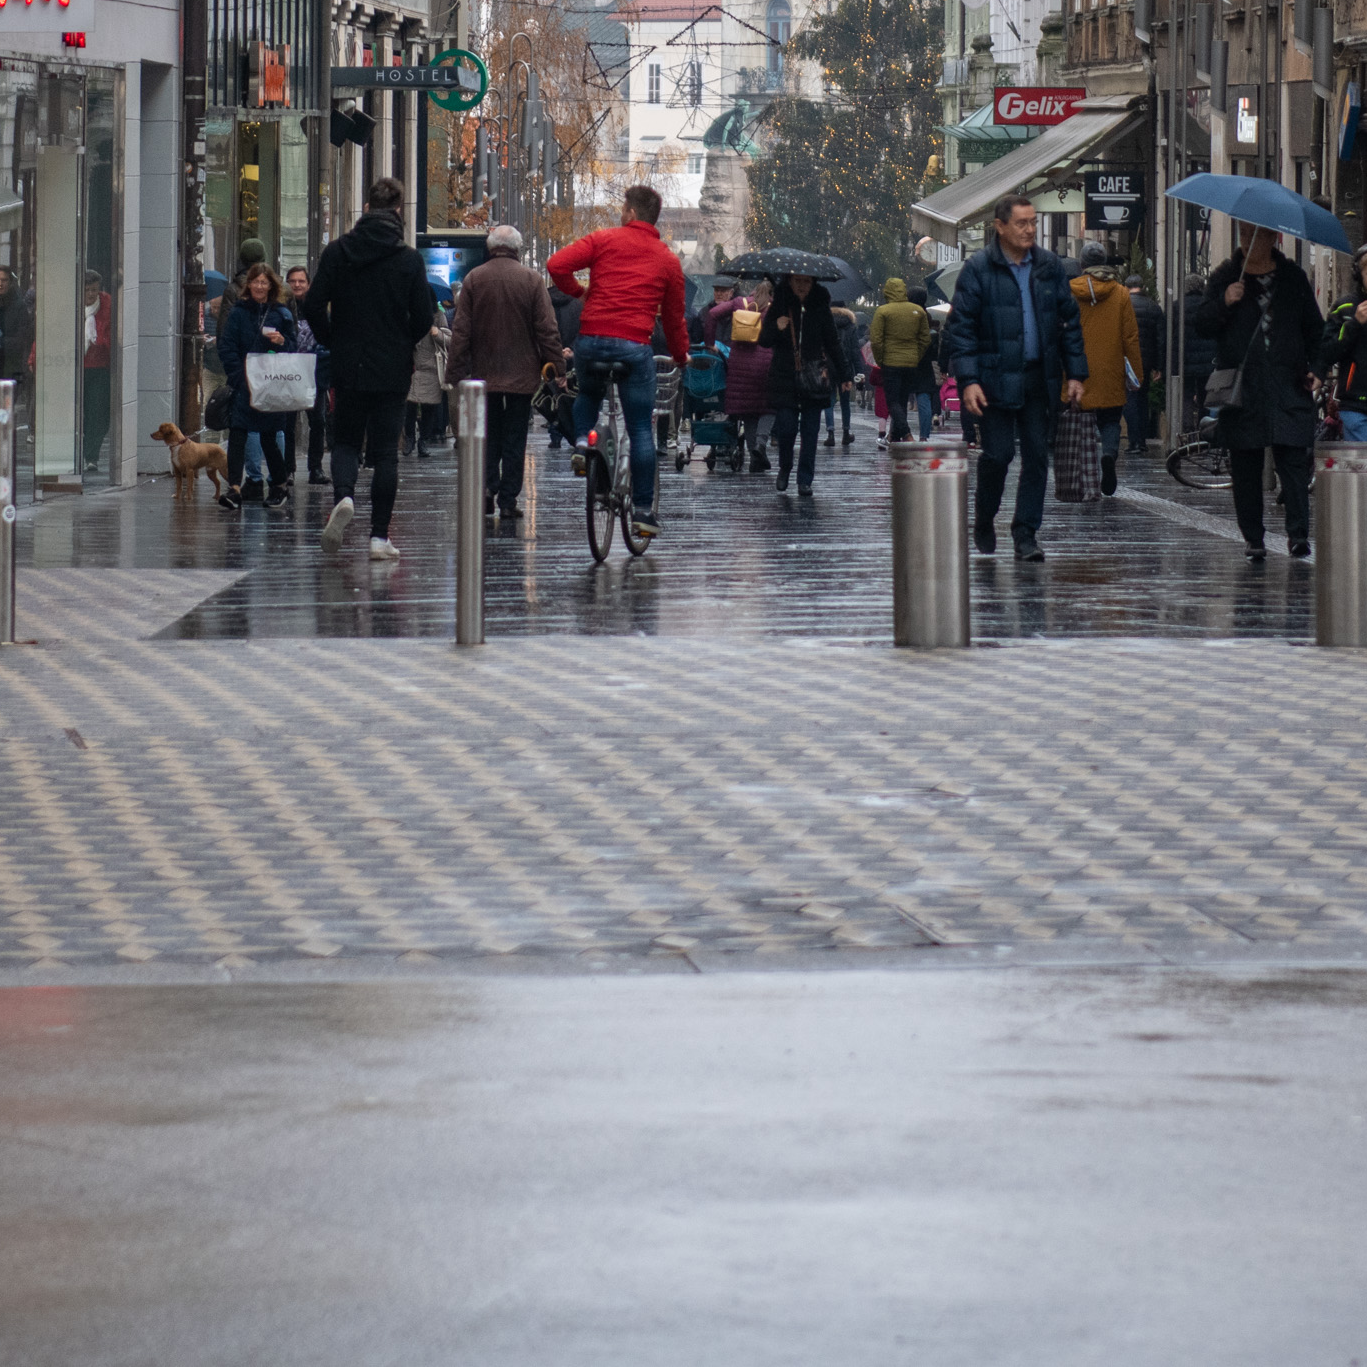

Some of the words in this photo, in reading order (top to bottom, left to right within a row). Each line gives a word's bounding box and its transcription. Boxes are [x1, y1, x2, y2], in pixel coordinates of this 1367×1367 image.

[375, 69, 452, 82] HOSTEL
[998, 92, 1066, 119] Felix
[1098, 176, 1130, 193] CAFE
[264, 374, 302, 382] MANGO
